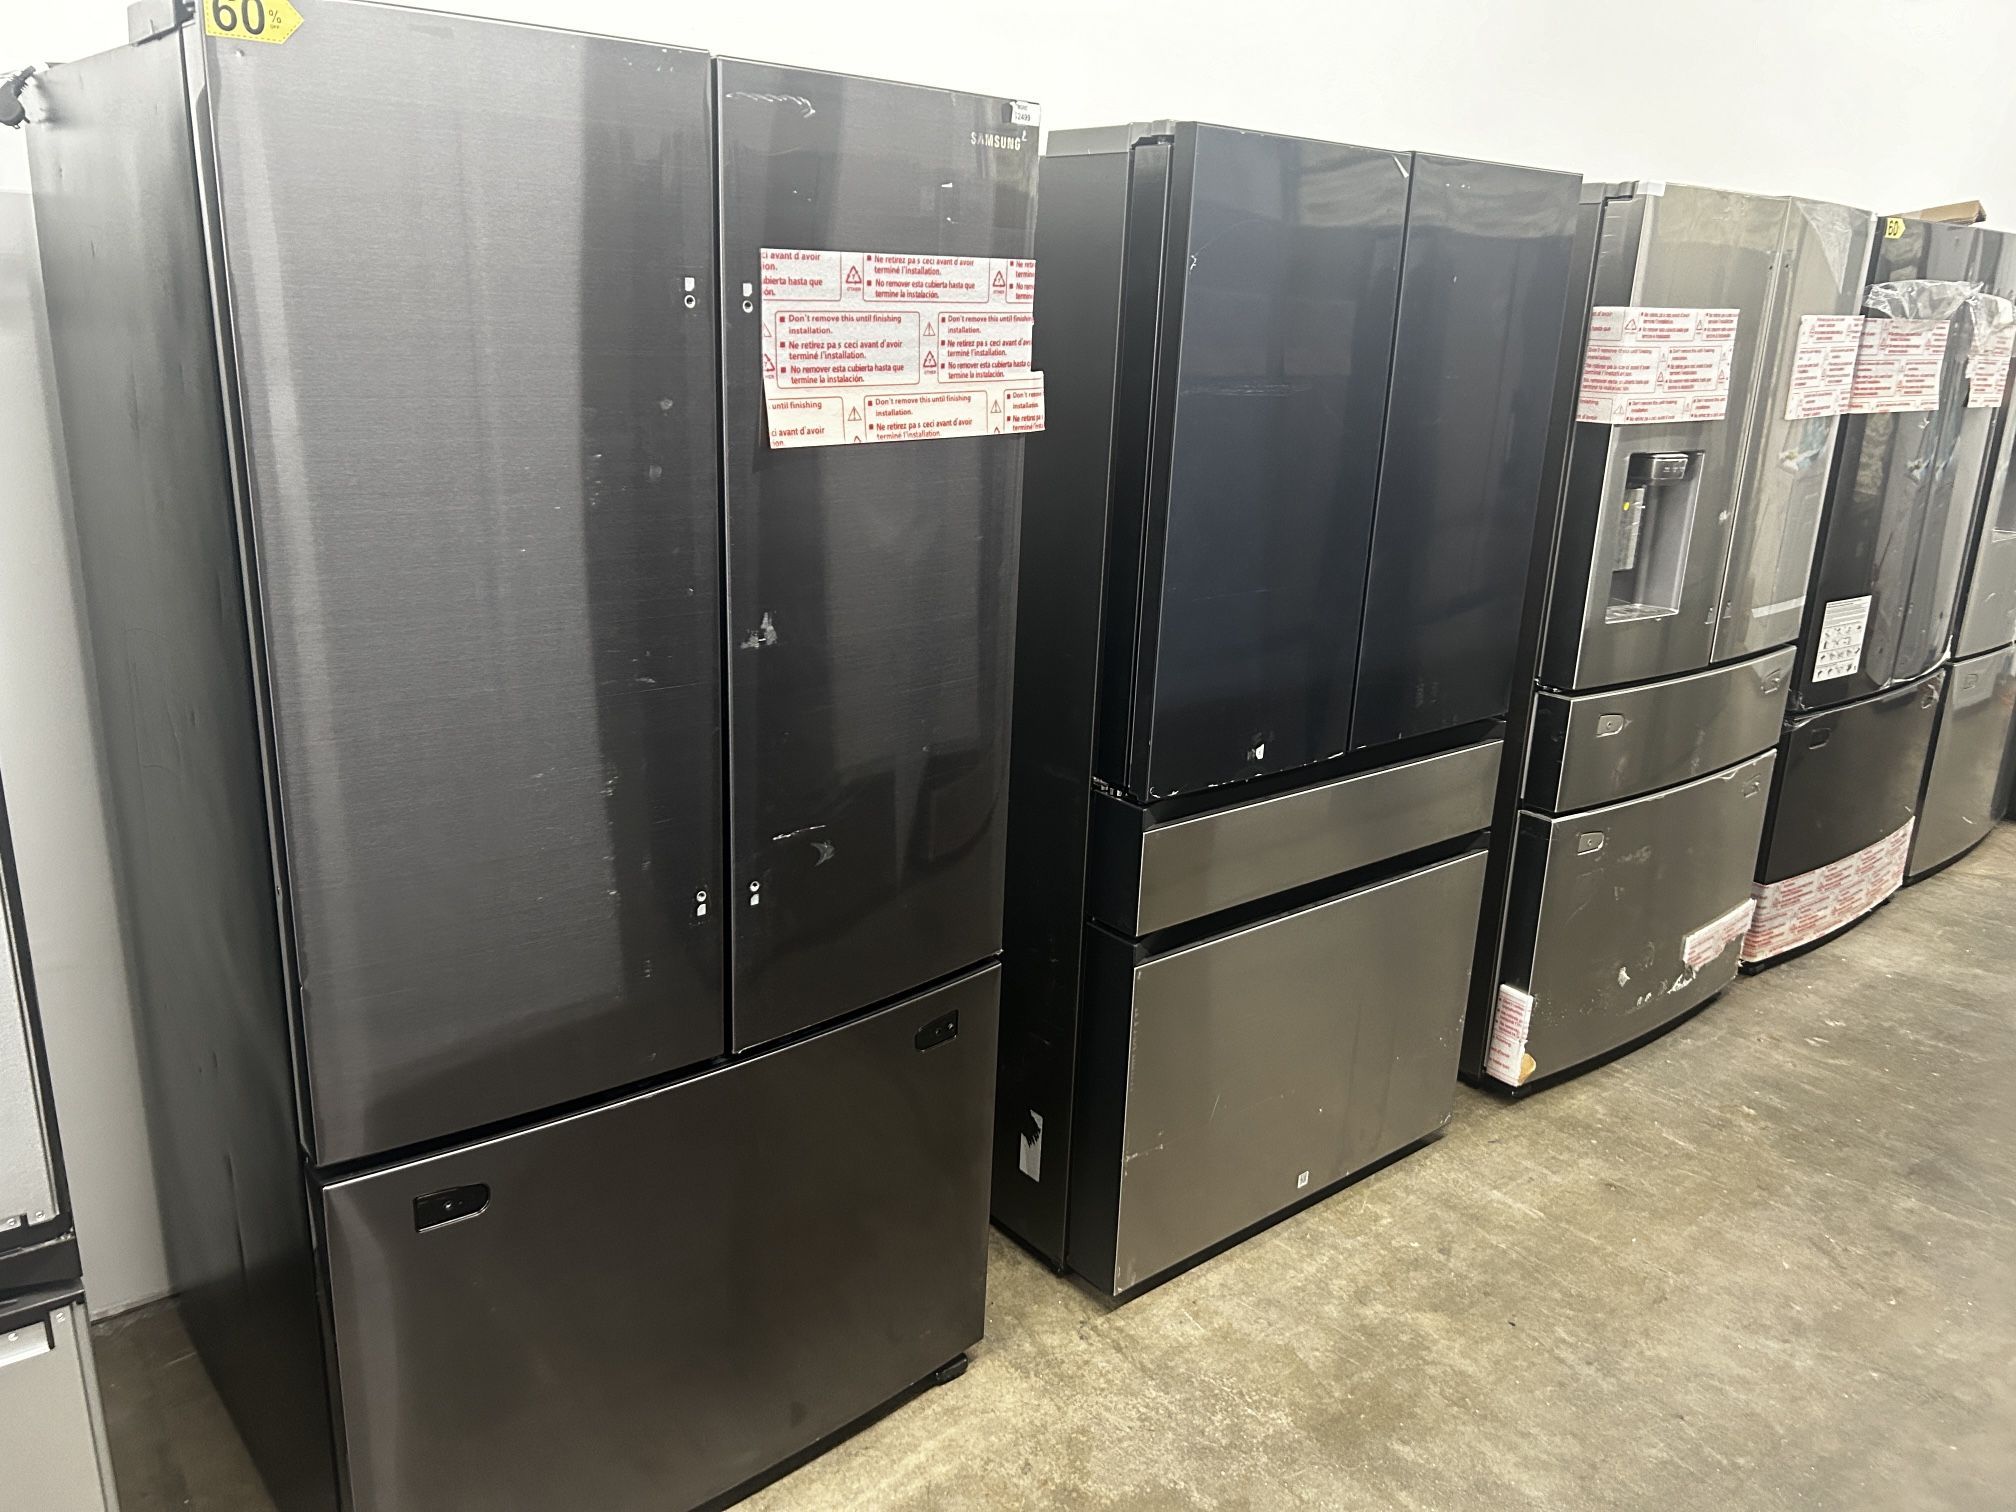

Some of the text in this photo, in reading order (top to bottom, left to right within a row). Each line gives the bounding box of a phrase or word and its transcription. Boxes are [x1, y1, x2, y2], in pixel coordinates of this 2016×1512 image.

[212, 0, 282, 35] 60 %
[970, 132, 1021, 150] SAMSUNG
[874, 255, 883, 263] Ne
[885, 256, 905, 264] retirez
[874, 264, 900, 274] terminé
[788, 276, 807, 286] hasta
[809, 279, 823, 288] que
[925, 280, 947, 289] cubierta
[948, 280, 964, 289] hasta
[875, 290, 898, 298] termine
[789, 314, 810, 322] Don't
[873, 315, 902, 324] finishing
[789, 341, 799, 349] Ne
[801, 341, 825, 349] retirez
[844, 340, 858, 349] ceci
[880, 339, 903, 348] d'avoir
[789, 351, 866, 360] terminé l'installation.
[948, 349, 969, 357] terminé
[791, 365, 801, 374] No
[847, 364, 873, 372] cubierta
[875, 363, 891, 372] hasta
[791, 375, 864, 384] termine la instalación.
[790, 401, 822, 410] finishing
[876, 398, 895, 406] Don't
[946, 395, 971, 403] finishing
[876, 409, 912, 417] installation.
[876, 423, 885, 431] Ne
[887, 422, 906, 431] retirez
[953, 418, 972, 427] d'avoir
[778, 428, 798, 436] avant
[800, 426, 824, 435] d'avoir
